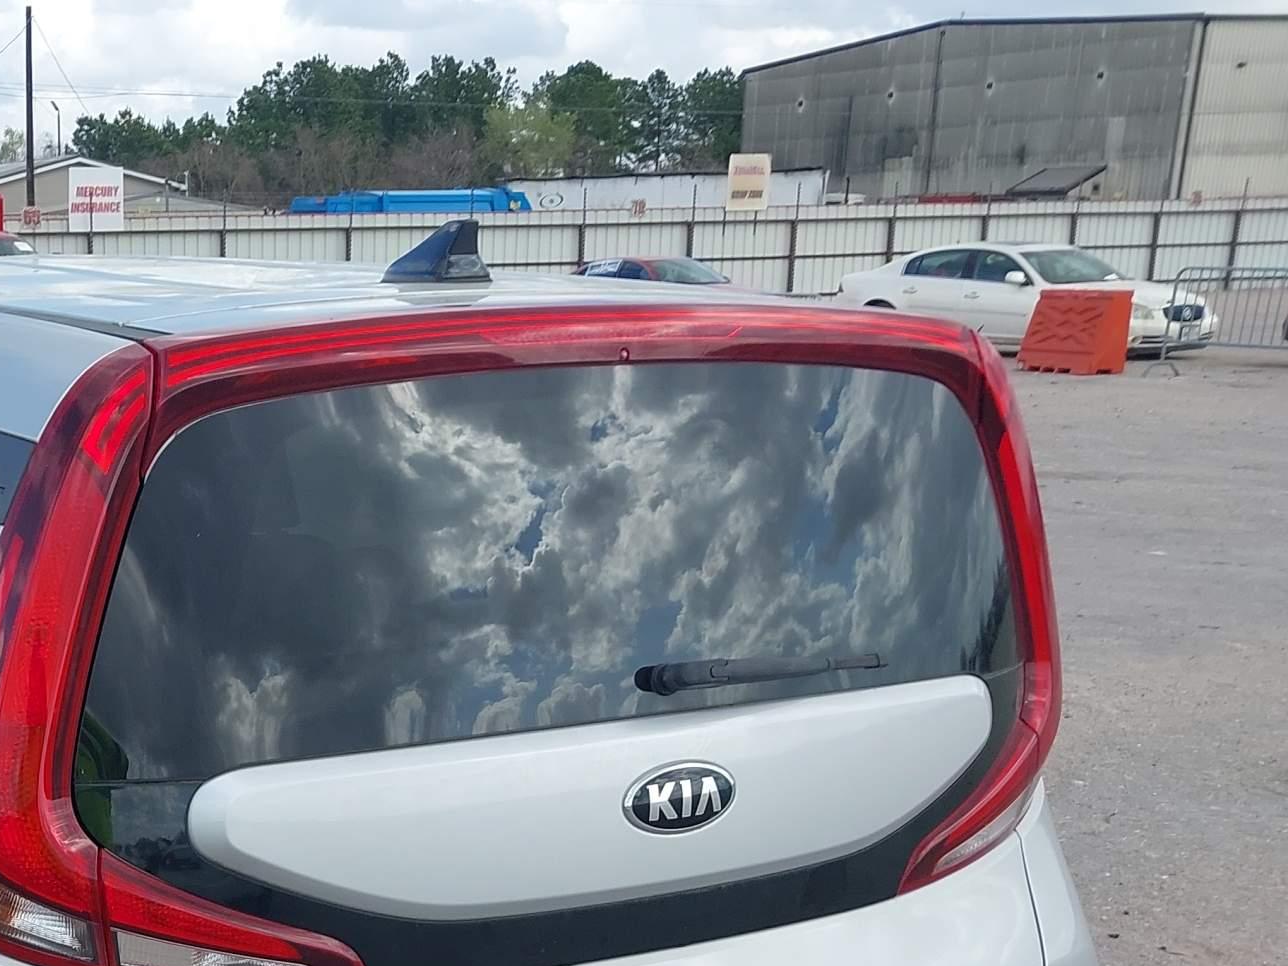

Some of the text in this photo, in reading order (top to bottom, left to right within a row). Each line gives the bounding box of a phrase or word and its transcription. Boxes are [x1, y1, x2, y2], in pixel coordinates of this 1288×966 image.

[76, 186, 119, 197] MERCURY
[71, 202, 121, 213] INSURANCE
[646, 776, 722, 821] KIA
